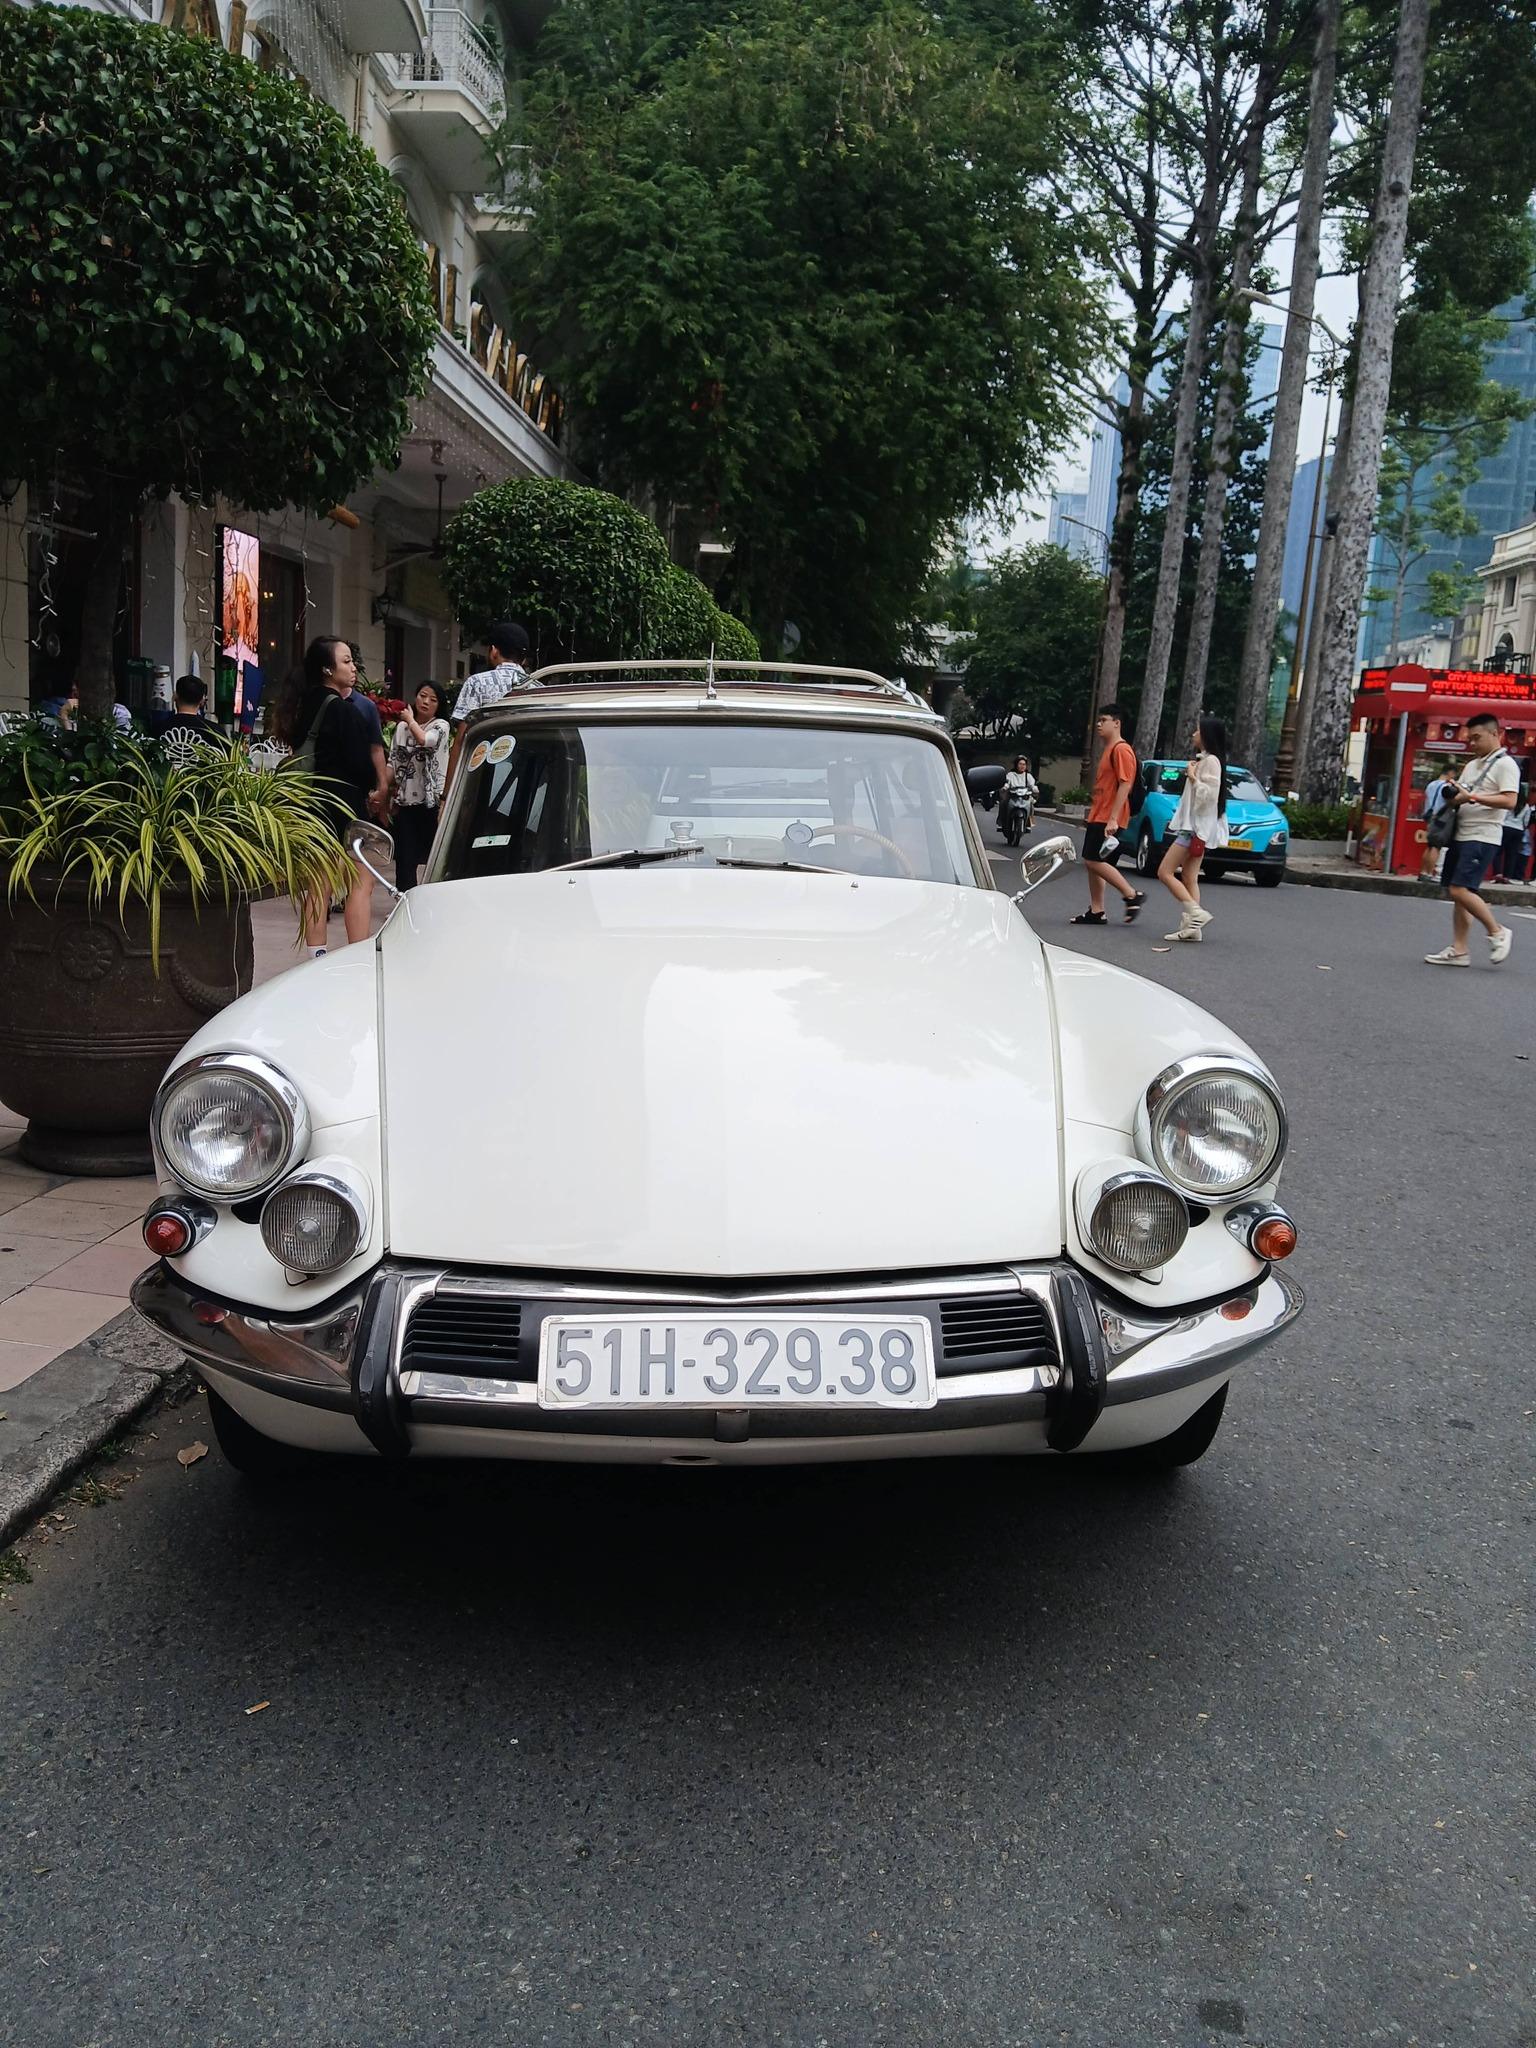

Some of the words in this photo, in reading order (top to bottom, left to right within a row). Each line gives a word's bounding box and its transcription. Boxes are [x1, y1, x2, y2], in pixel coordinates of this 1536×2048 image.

[1448, 673, 1467, 681] CITY
[1432, 681, 1450, 689] CITY
[1451, 682, 1474, 691] TOUR
[1505, 685, 1529, 694] TOWN
[556, 1328, 916, 1395] 51H-329.38
